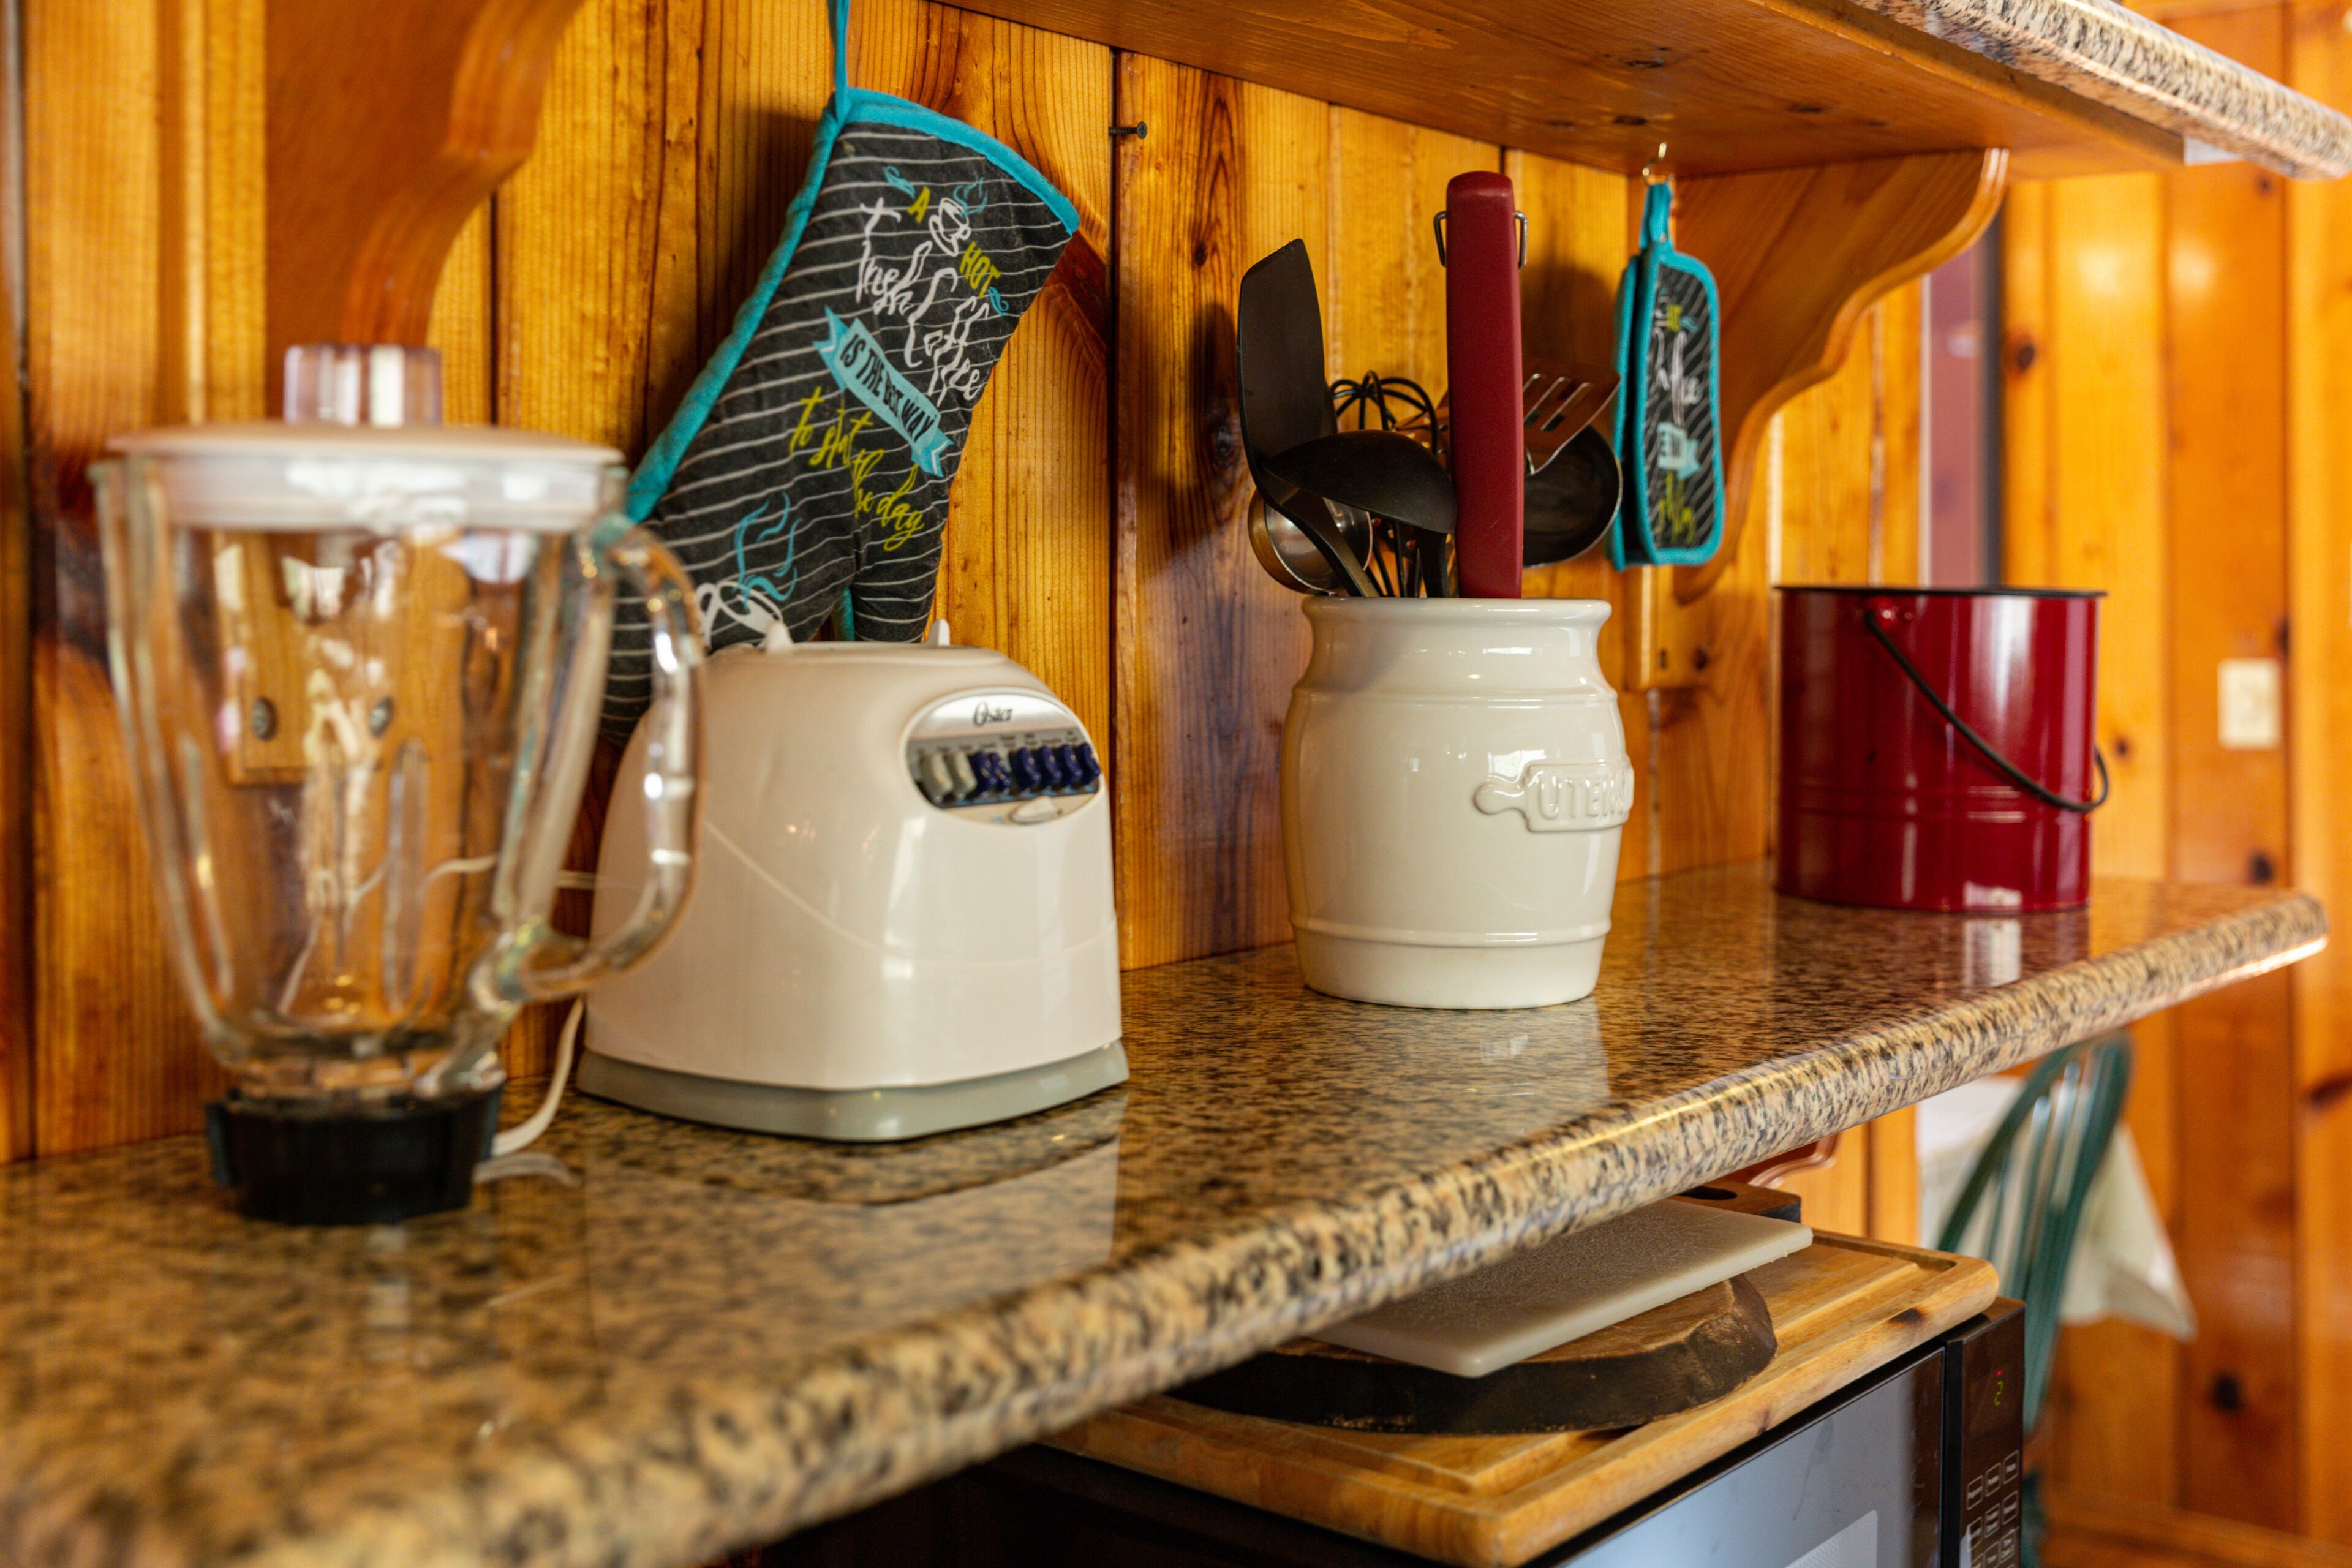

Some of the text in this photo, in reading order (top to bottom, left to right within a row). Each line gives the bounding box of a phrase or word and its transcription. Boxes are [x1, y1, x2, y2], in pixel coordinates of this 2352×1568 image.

[908, 186, 1001, 299] A HOT
[840, 333, 867, 368] IS
[856, 348, 884, 397] THE
[901, 399, 936, 443] WAY
[904, 267, 989, 407] Coffee
[790, 385, 824, 459] to
[808, 404, 874, 469] stat
[876, 463, 925, 552] day
